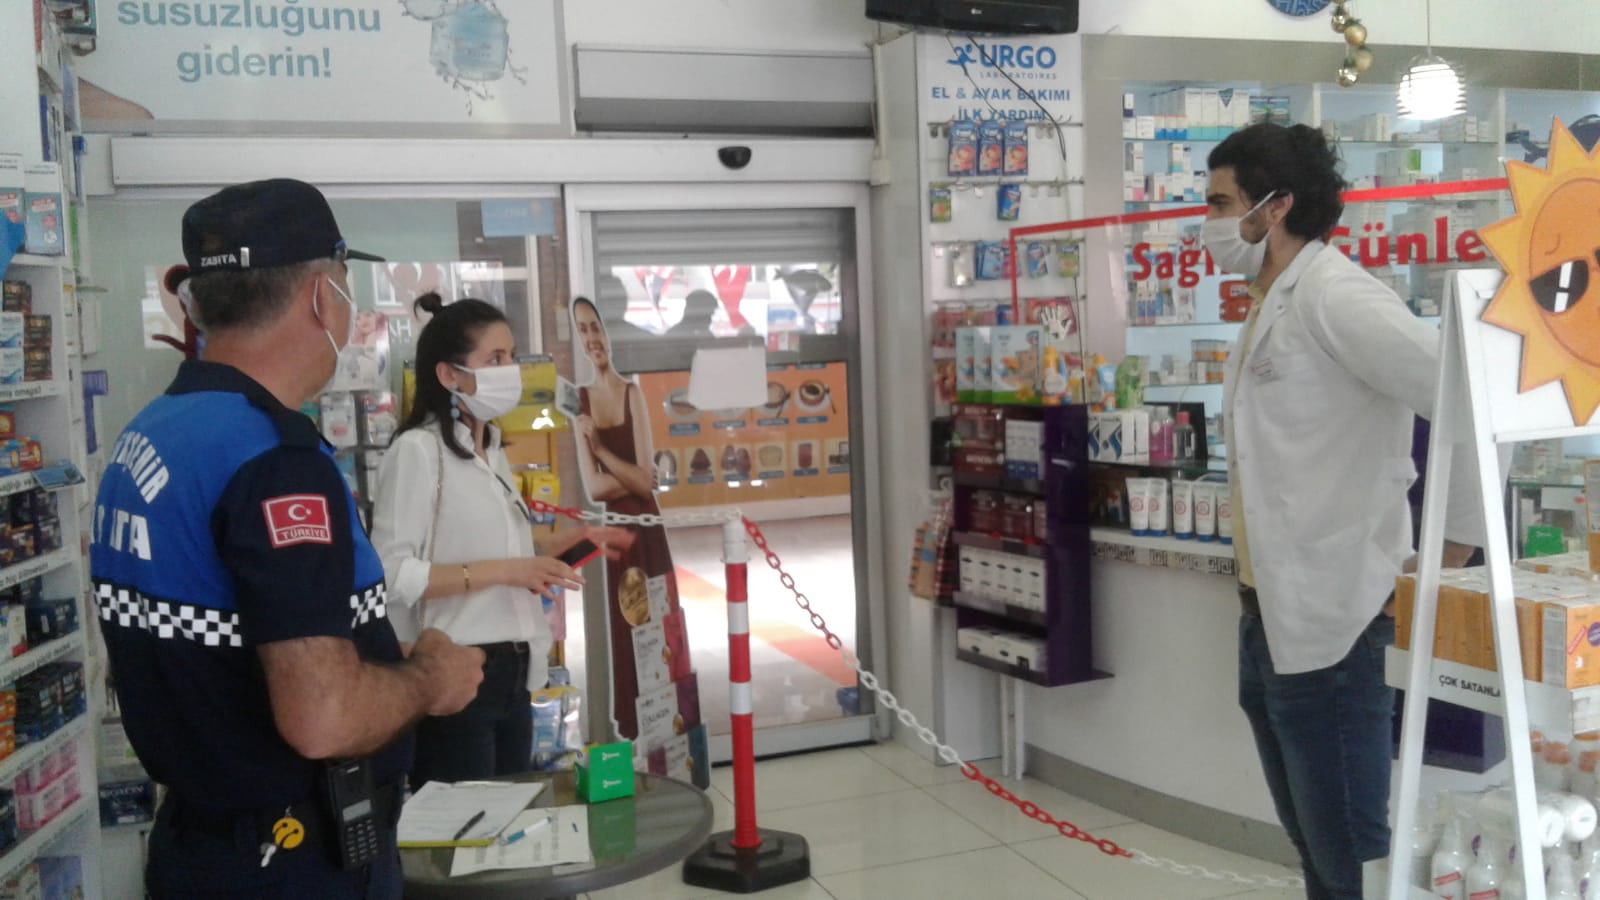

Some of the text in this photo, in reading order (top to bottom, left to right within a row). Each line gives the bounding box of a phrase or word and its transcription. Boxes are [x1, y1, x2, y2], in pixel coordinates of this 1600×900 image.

[117, 0, 382, 37] susuzluğunu
[176, 45, 332, 84] giderin!
[979, 44, 1057, 69] URGO
[980, 72, 1057, 80] LABORATOIRES
[931, 87, 1071, 101] EL & AYAK BAKIMI
[958, 106, 1046, 121] İLK YARDIM
[1325, 215, 1487, 268] Günle
[281, 527, 326, 540] TÜRKİYE
[1439, 675, 1501, 698] ÇOK SATANLA
